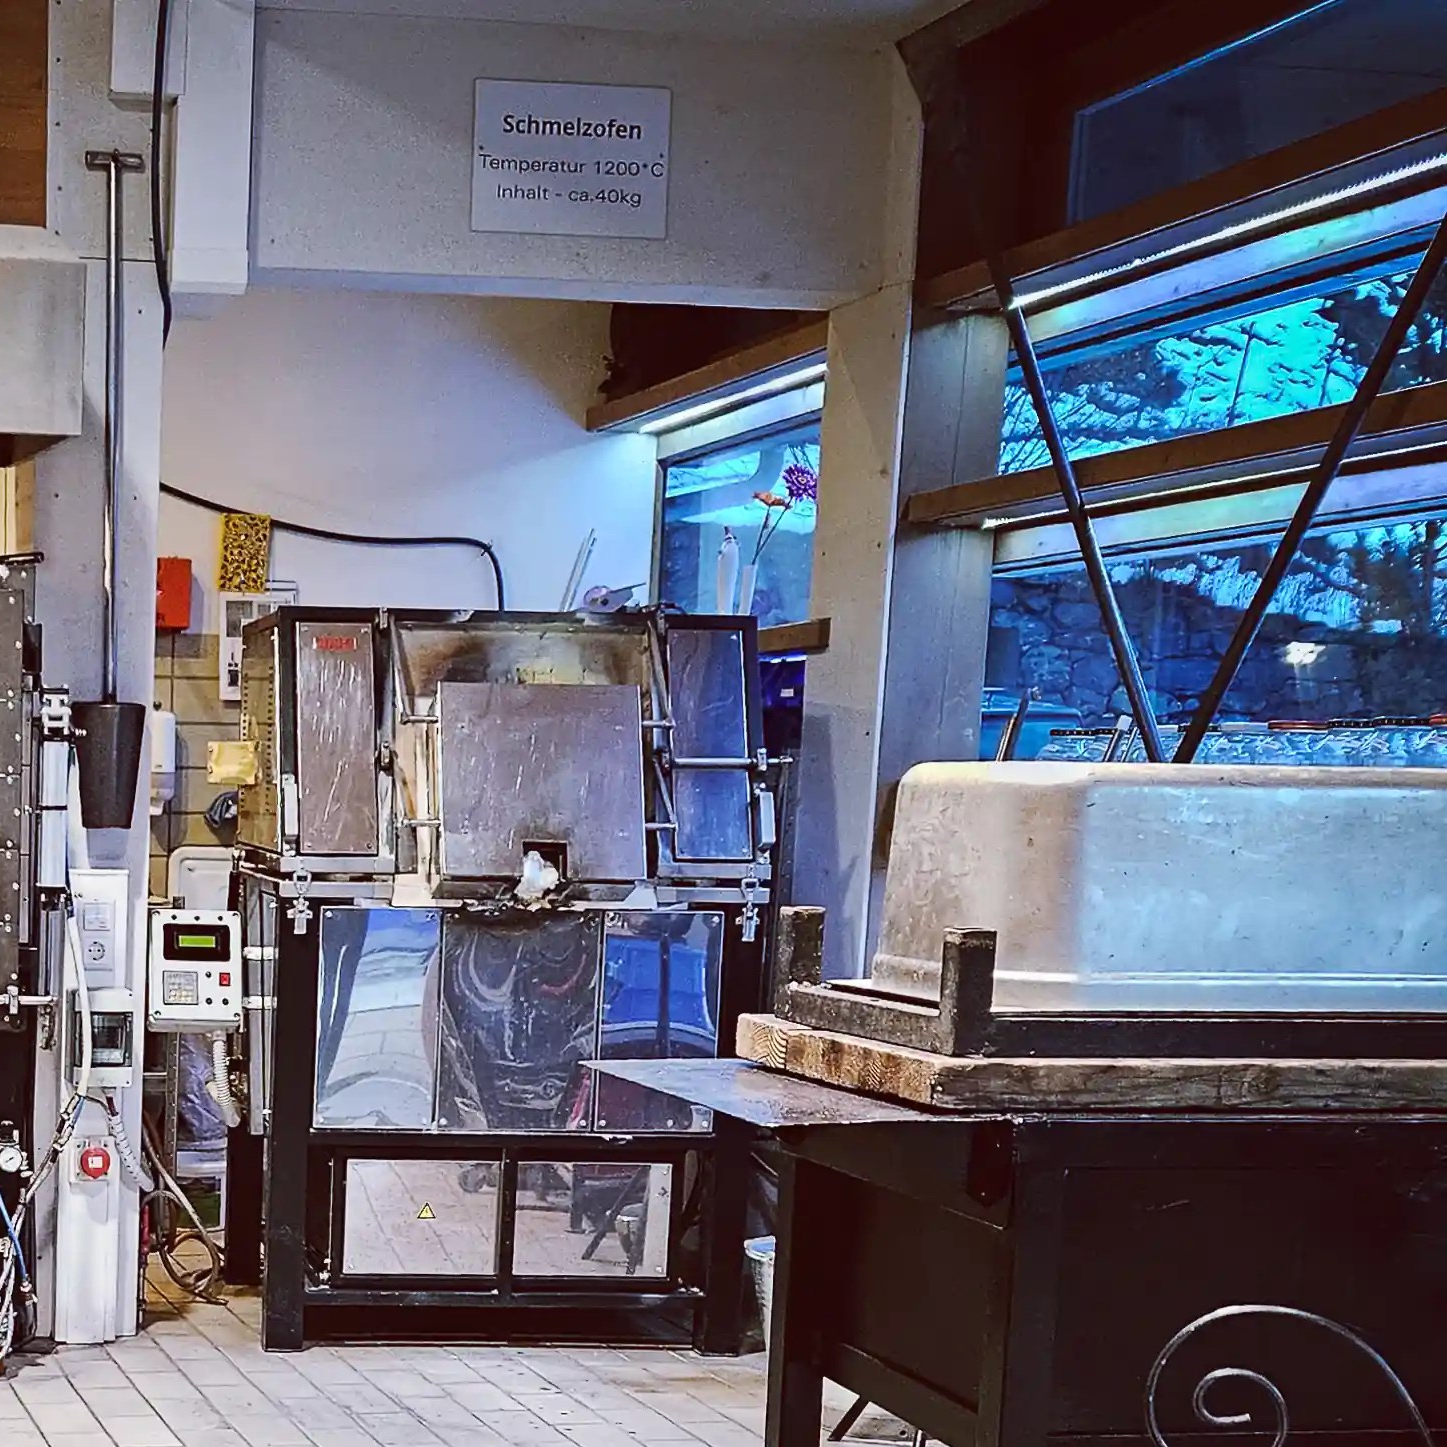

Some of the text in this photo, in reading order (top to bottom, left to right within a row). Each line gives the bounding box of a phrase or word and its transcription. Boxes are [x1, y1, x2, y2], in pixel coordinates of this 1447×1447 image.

[503, 114, 642, 140] Schmelzofen
[479, 153, 587, 174] Temperatur
[497, 184, 549, 201] Inhalt
[568, 189, 642, 208] ca.40kg
